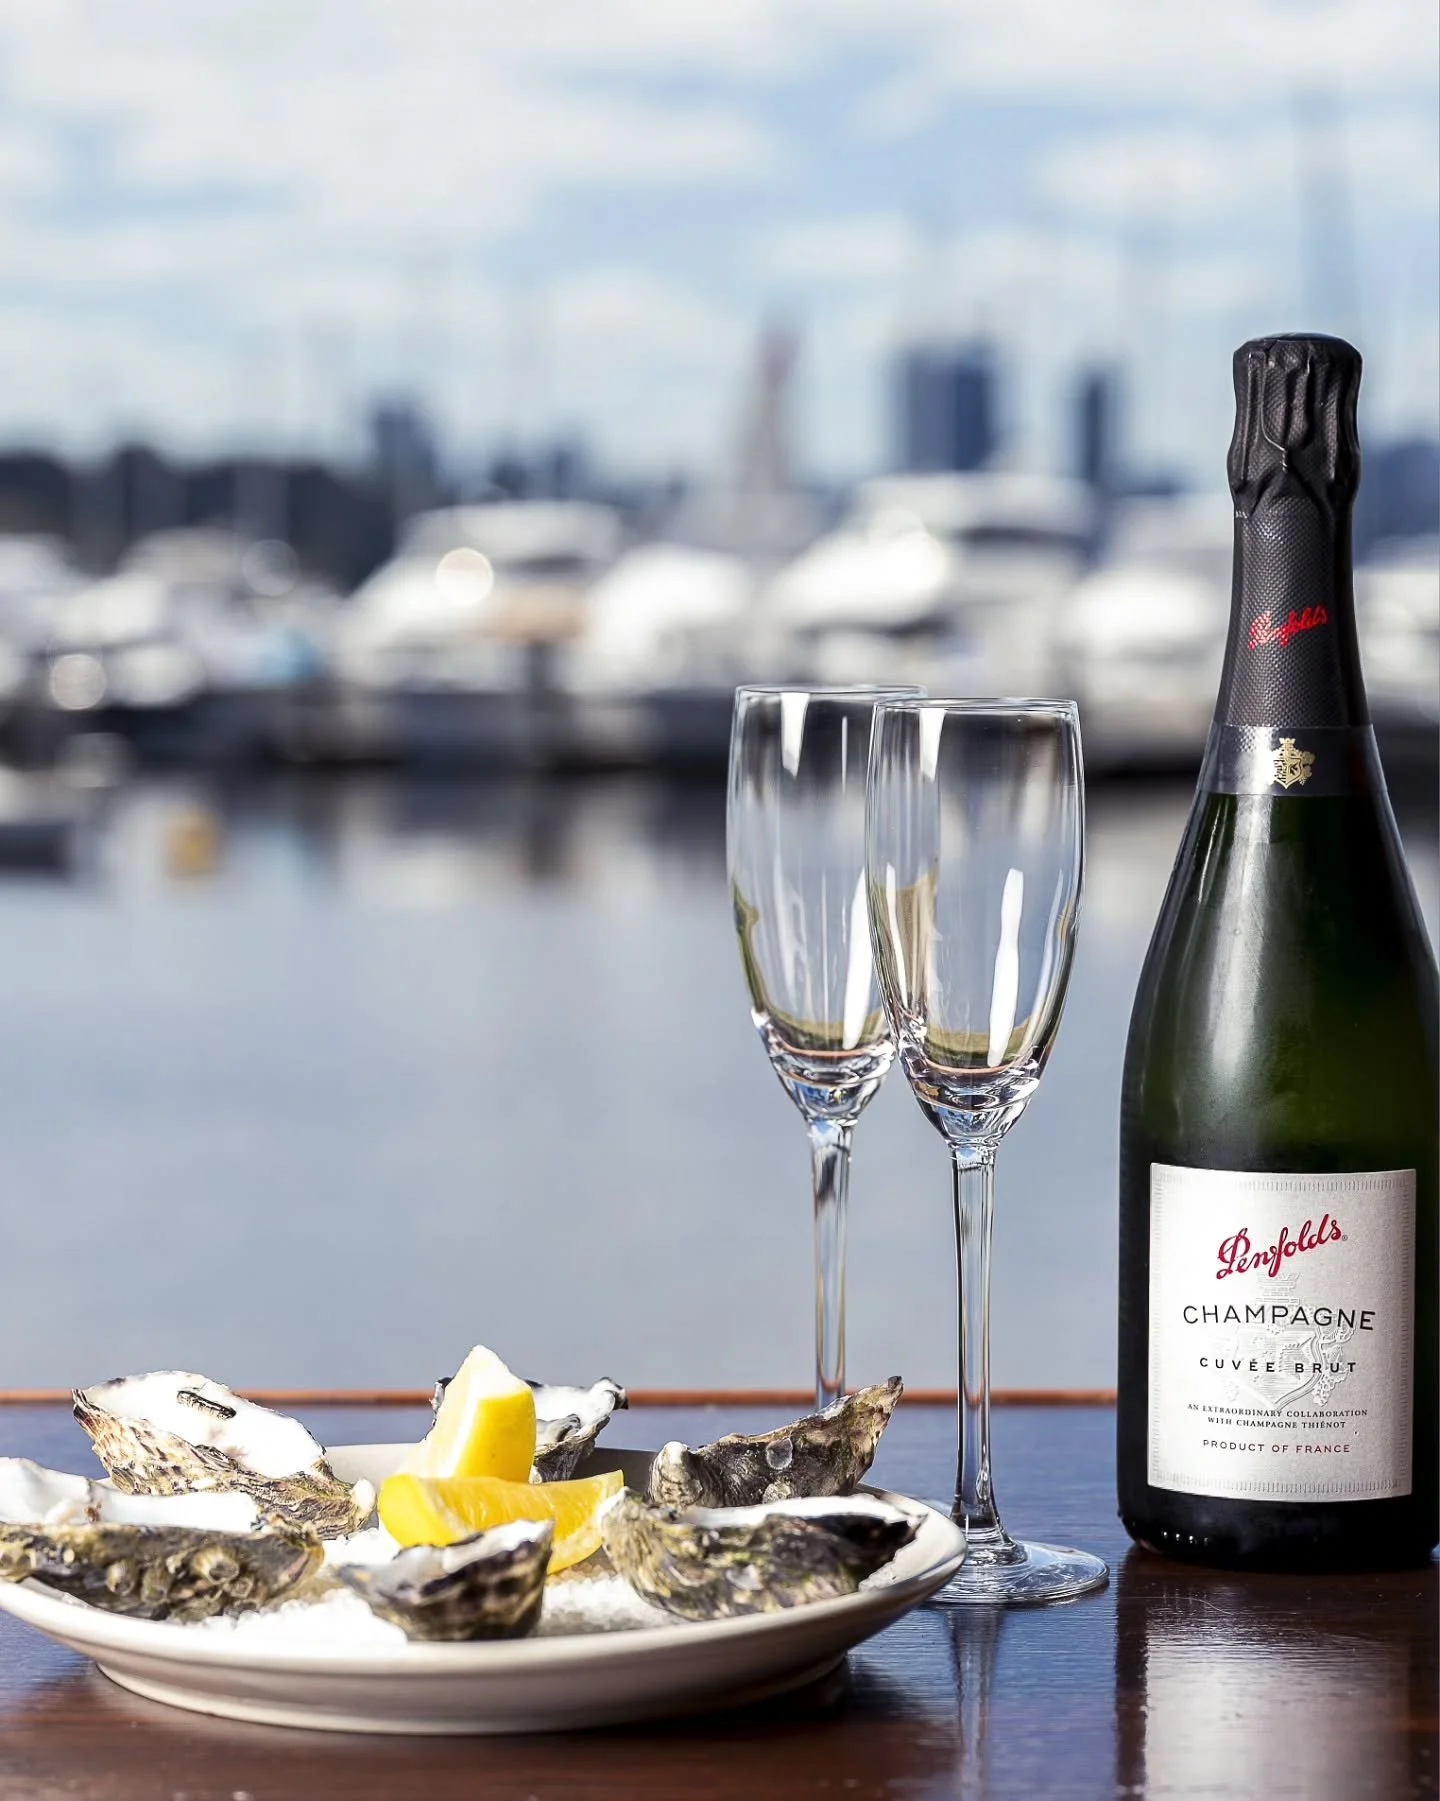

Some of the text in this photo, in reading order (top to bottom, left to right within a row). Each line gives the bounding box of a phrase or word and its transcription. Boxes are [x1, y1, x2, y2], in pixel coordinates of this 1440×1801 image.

[1216, 1213, 1343, 1280] Penfolds
[1183, 1304, 1376, 1331] CHAMPAGNE
[1199, 1356, 1357, 1374] CUVÉE BRUT
[1187, 1403, 1369, 1418] AN EXTRAORDINARY COLLABORATION
[1207, 1416, 1347, 1430] WITH CHAMPAGNE THIÉNOT
[1203, 1439, 1351, 1454] PRODUCT OF FRANCE
